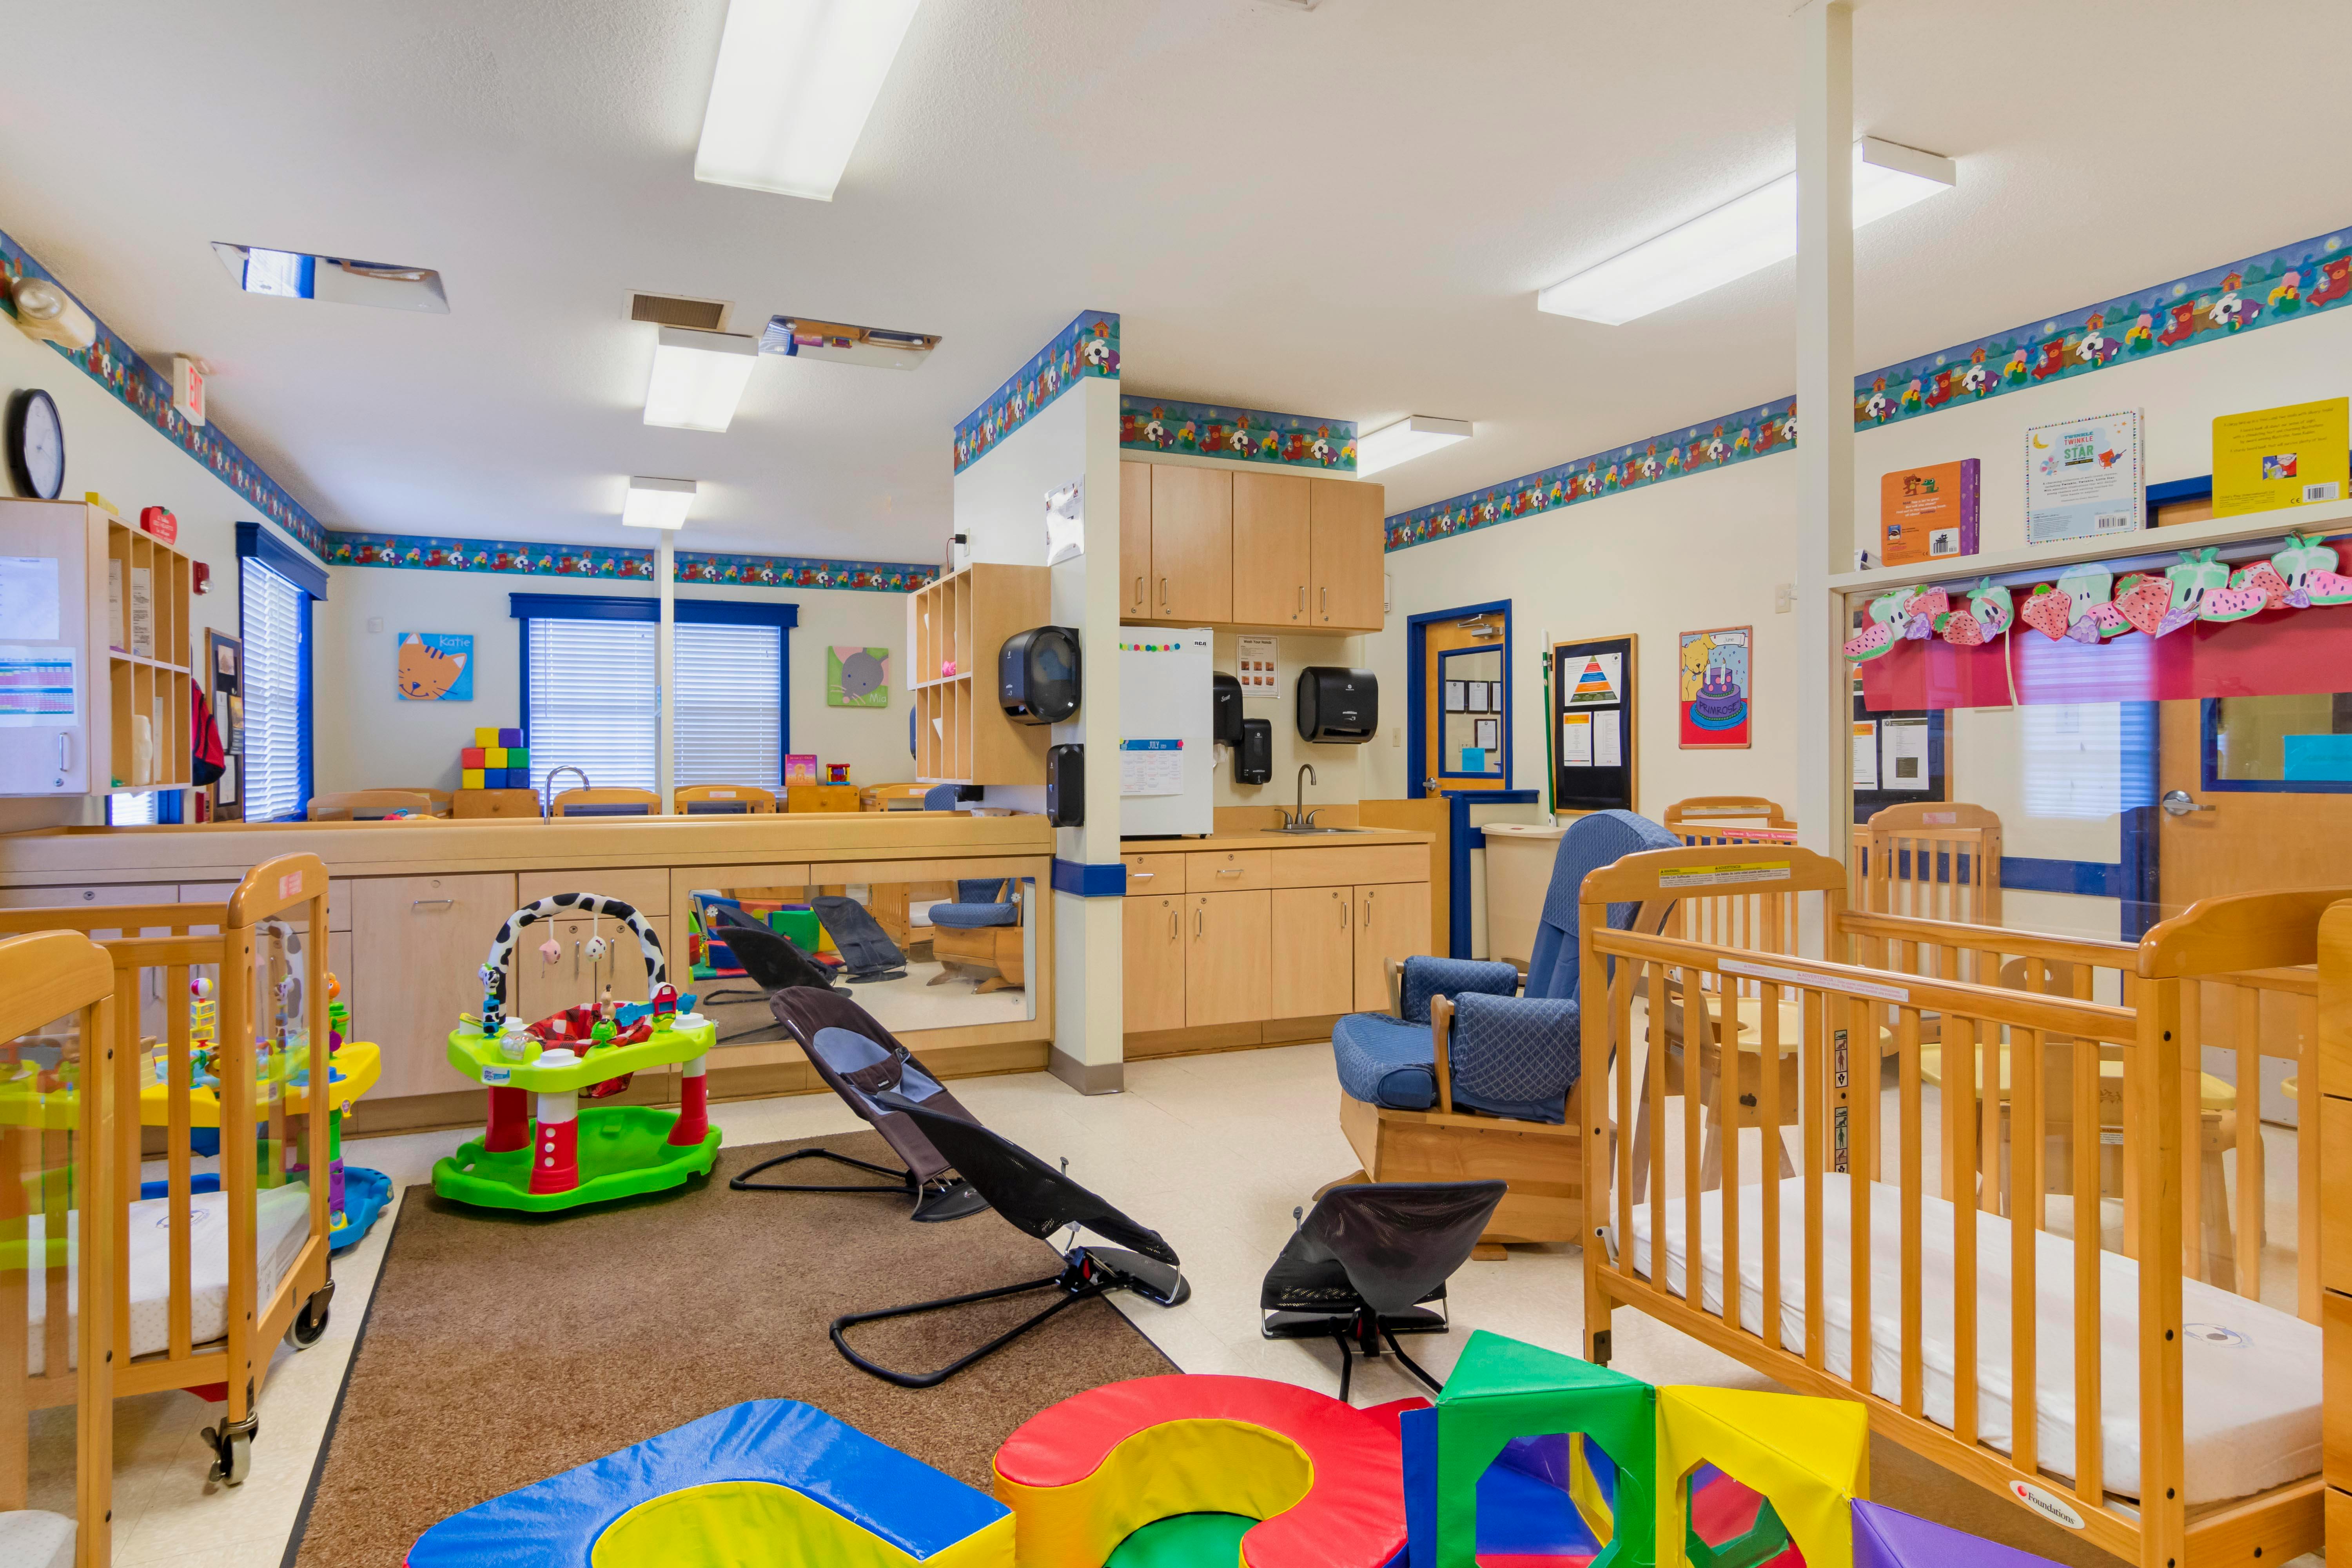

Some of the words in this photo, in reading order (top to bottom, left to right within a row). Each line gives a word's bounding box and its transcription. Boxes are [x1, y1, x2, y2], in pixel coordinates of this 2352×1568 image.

[189, 367, 202, 416] EXIT
[2064, 431, 2094, 439] TWINKLE
[2064, 436, 2093, 445] TWINKLE
[2064, 445, 2094, 459] STAR
[439, 635, 470, 646] Katie
[869, 693, 887, 703] Mia
[1699, 701, 1738, 715] PRIMROSE
[1802, 973, 1834, 982] ADVERTENCIA
[2028, 1492, 2074, 1524] Foundations
